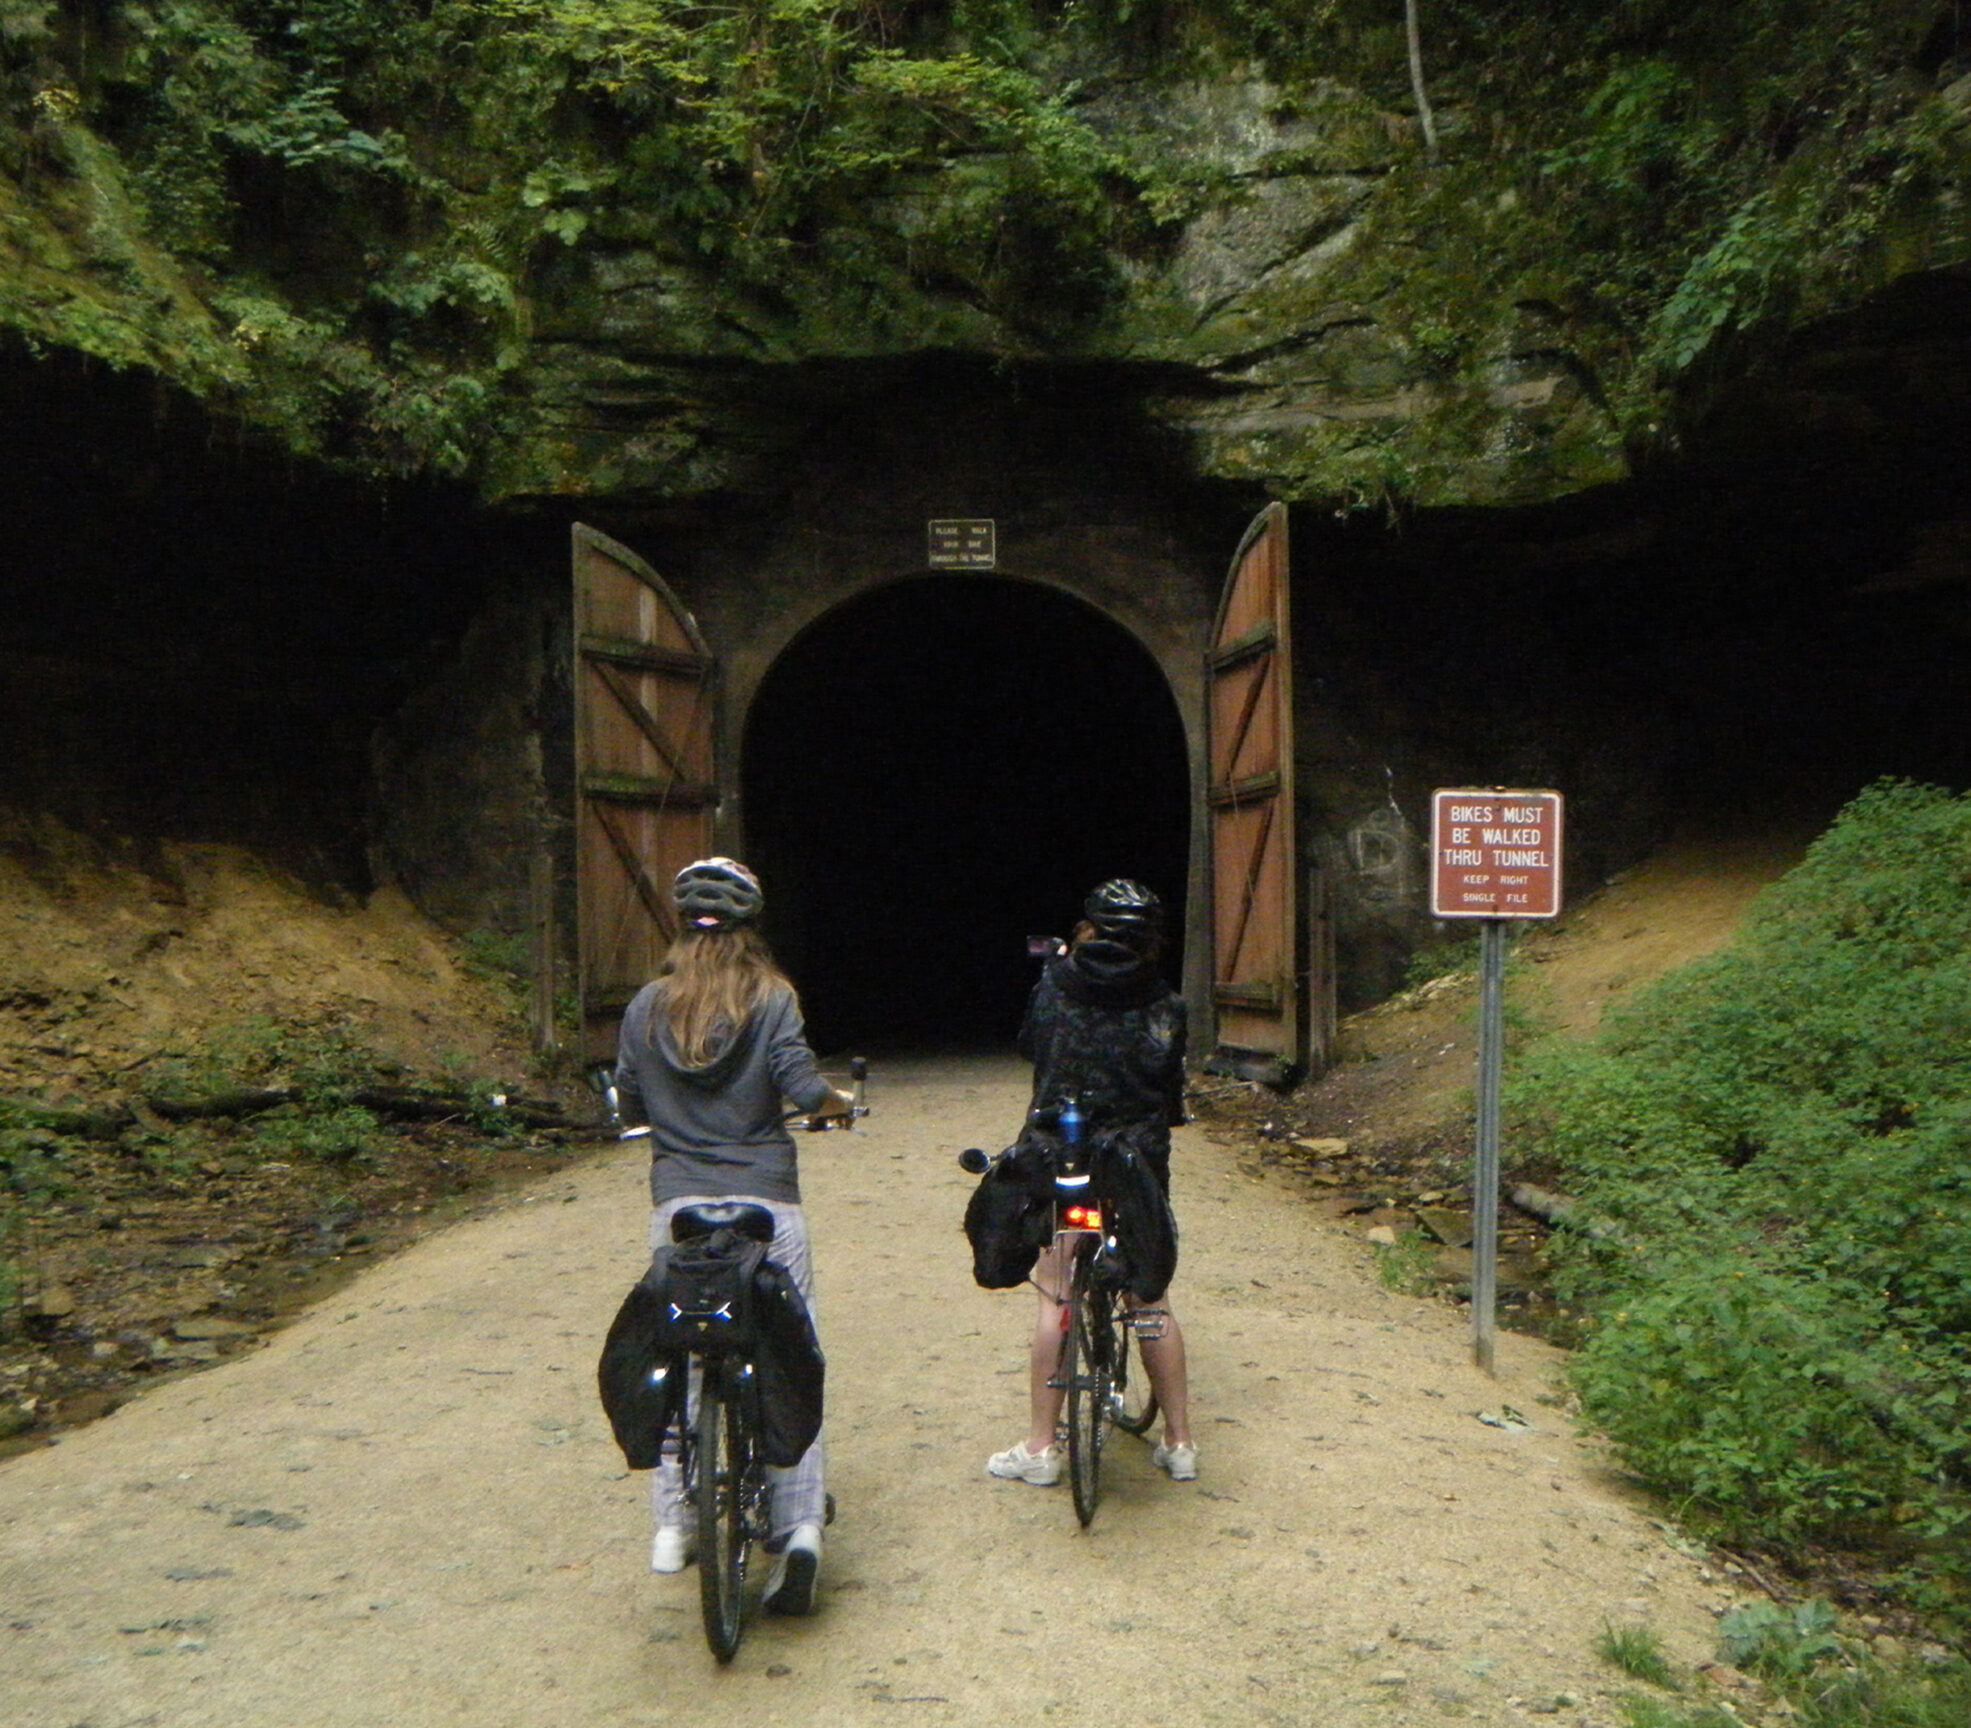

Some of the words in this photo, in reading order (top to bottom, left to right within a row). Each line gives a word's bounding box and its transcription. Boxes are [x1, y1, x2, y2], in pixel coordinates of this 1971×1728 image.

[1450, 806, 1493, 823] BIKES
[1503, 806, 1544, 824] MUST
[1452, 827, 1472, 844] BE
[1482, 828, 1541, 845] WALKED
[1444, 848, 1482, 866] THRU
[1492, 849, 1549, 867] TUNNEL
[1463, 874, 1490, 885] KEEP
[1500, 875, 1529, 885] RIGHT
[1463, 892, 1497, 903] SINGLE
[1506, 893, 1529, 904] FILE
